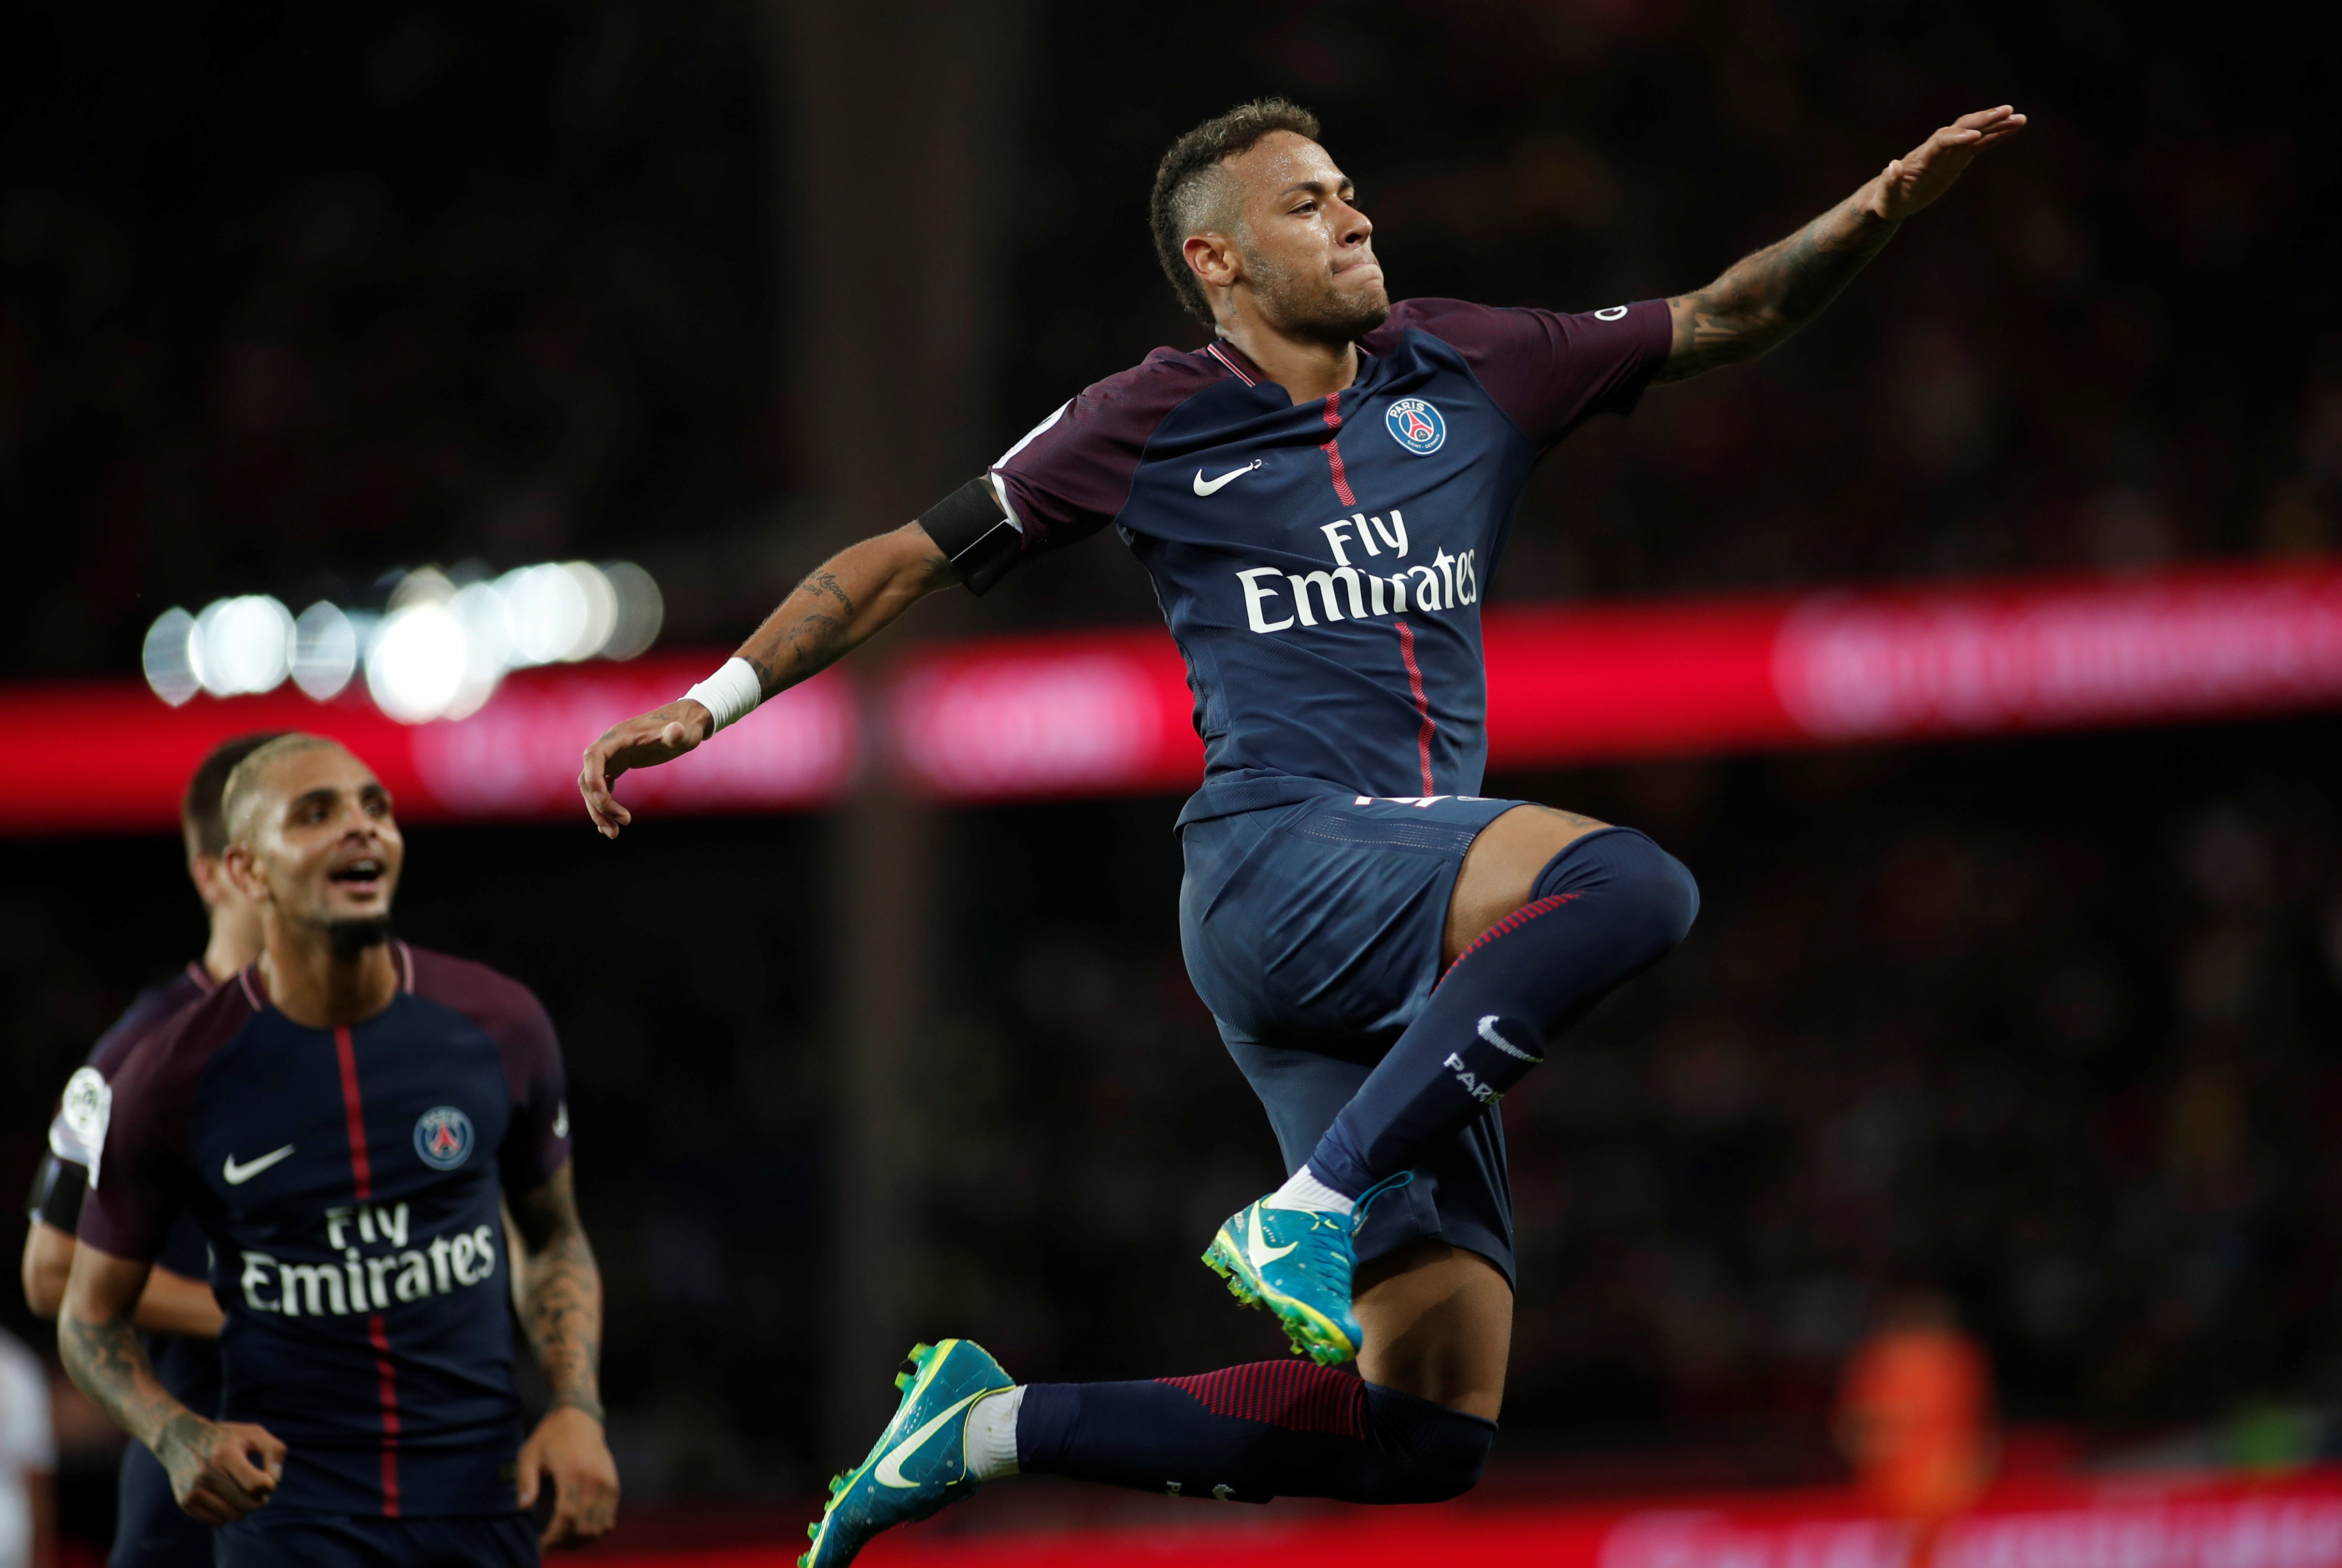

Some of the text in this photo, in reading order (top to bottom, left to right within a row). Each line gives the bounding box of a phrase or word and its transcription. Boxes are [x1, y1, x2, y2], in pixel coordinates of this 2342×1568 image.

[1389, 401, 1425, 418] PARIS
[1319, 509, 1409, 567] Fly
[1235, 546, 1477, 634] Emirates
[324, 1202, 410, 1250] Fly
[241, 1224, 496, 1316] Emirates
